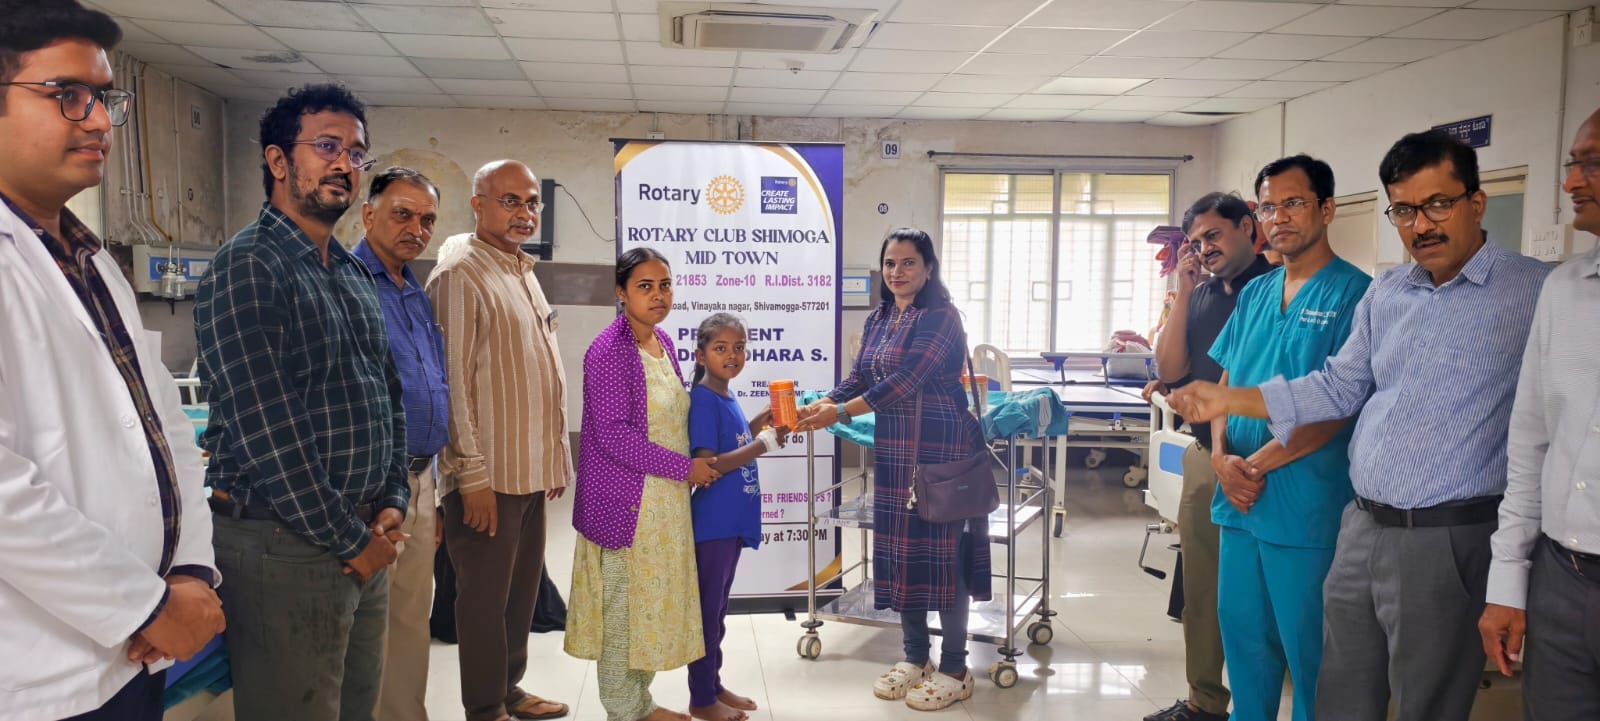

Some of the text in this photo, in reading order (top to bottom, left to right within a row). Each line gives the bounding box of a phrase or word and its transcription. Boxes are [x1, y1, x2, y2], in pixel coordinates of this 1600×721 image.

[885, 144, 898, 155] 09
[639, 184, 701, 205] Rotary
[628, 227, 830, 244] ROTARY CLUB SHIMOGA
[685, 251, 779, 265] MID TOWN
[676, 274, 832, 287] 21853 Zone-10 R.I.Dist. 3182
[691, 302, 727, 313] Vinayaka
[728, 303, 751, 313] nagar,
[754, 301, 830, 313] Shivamogga-577201
[811, 349, 828, 361] S.
[737, 390, 748, 398] Dr.
[792, 432, 804, 444] do
[773, 531, 784, 542] at
[786, 529, 809, 542] 7:30
